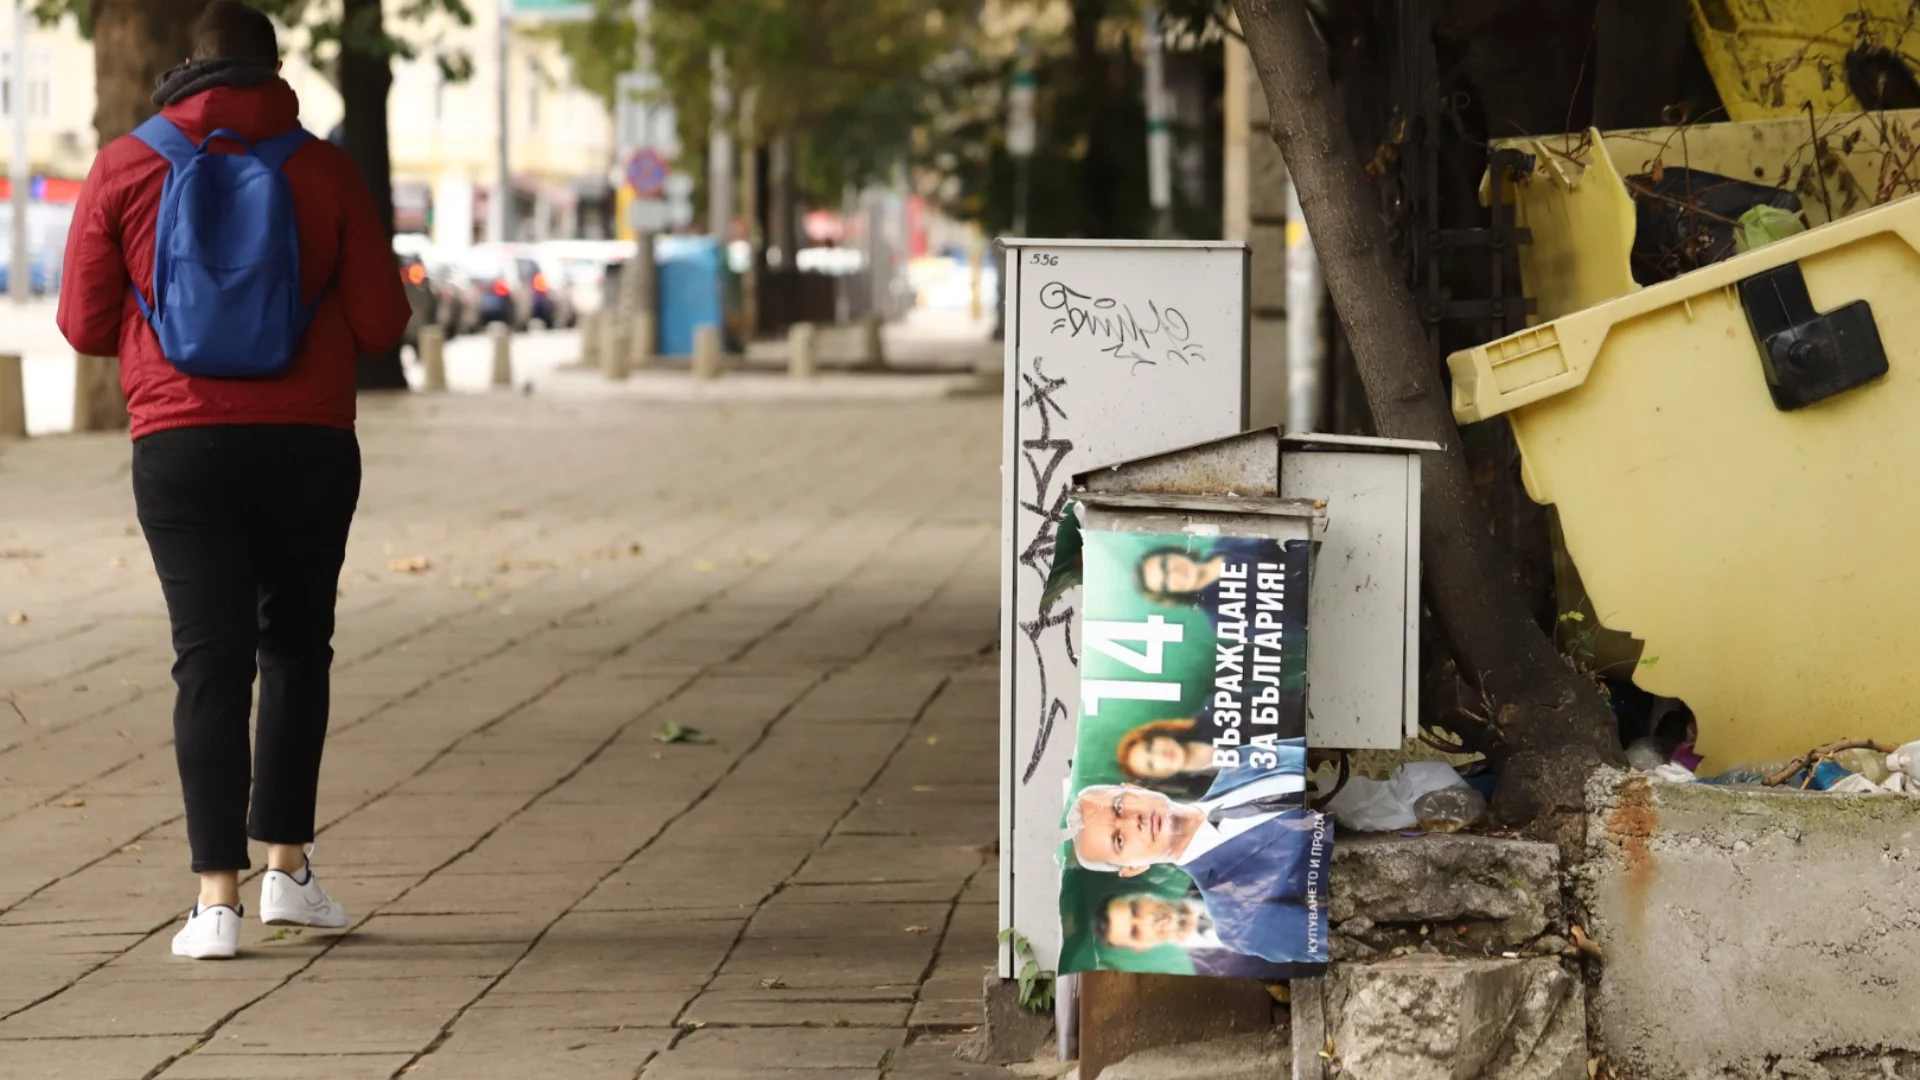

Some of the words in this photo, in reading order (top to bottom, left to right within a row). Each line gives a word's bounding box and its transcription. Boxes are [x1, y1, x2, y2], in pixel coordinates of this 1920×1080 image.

[1030, 253, 1059, 266] 556
[1081, 614, 1184, 716] 14
[1212, 562, 1249, 768] ВЪЗРАЖДАНЕ
[1250, 562, 1286, 725] БЪЛГАРИЯ!
[1249, 732, 1279, 769] ЗА
[1309, 858, 1321, 869] И
[1308, 870, 1319, 953] КУПУВАНЕТО
